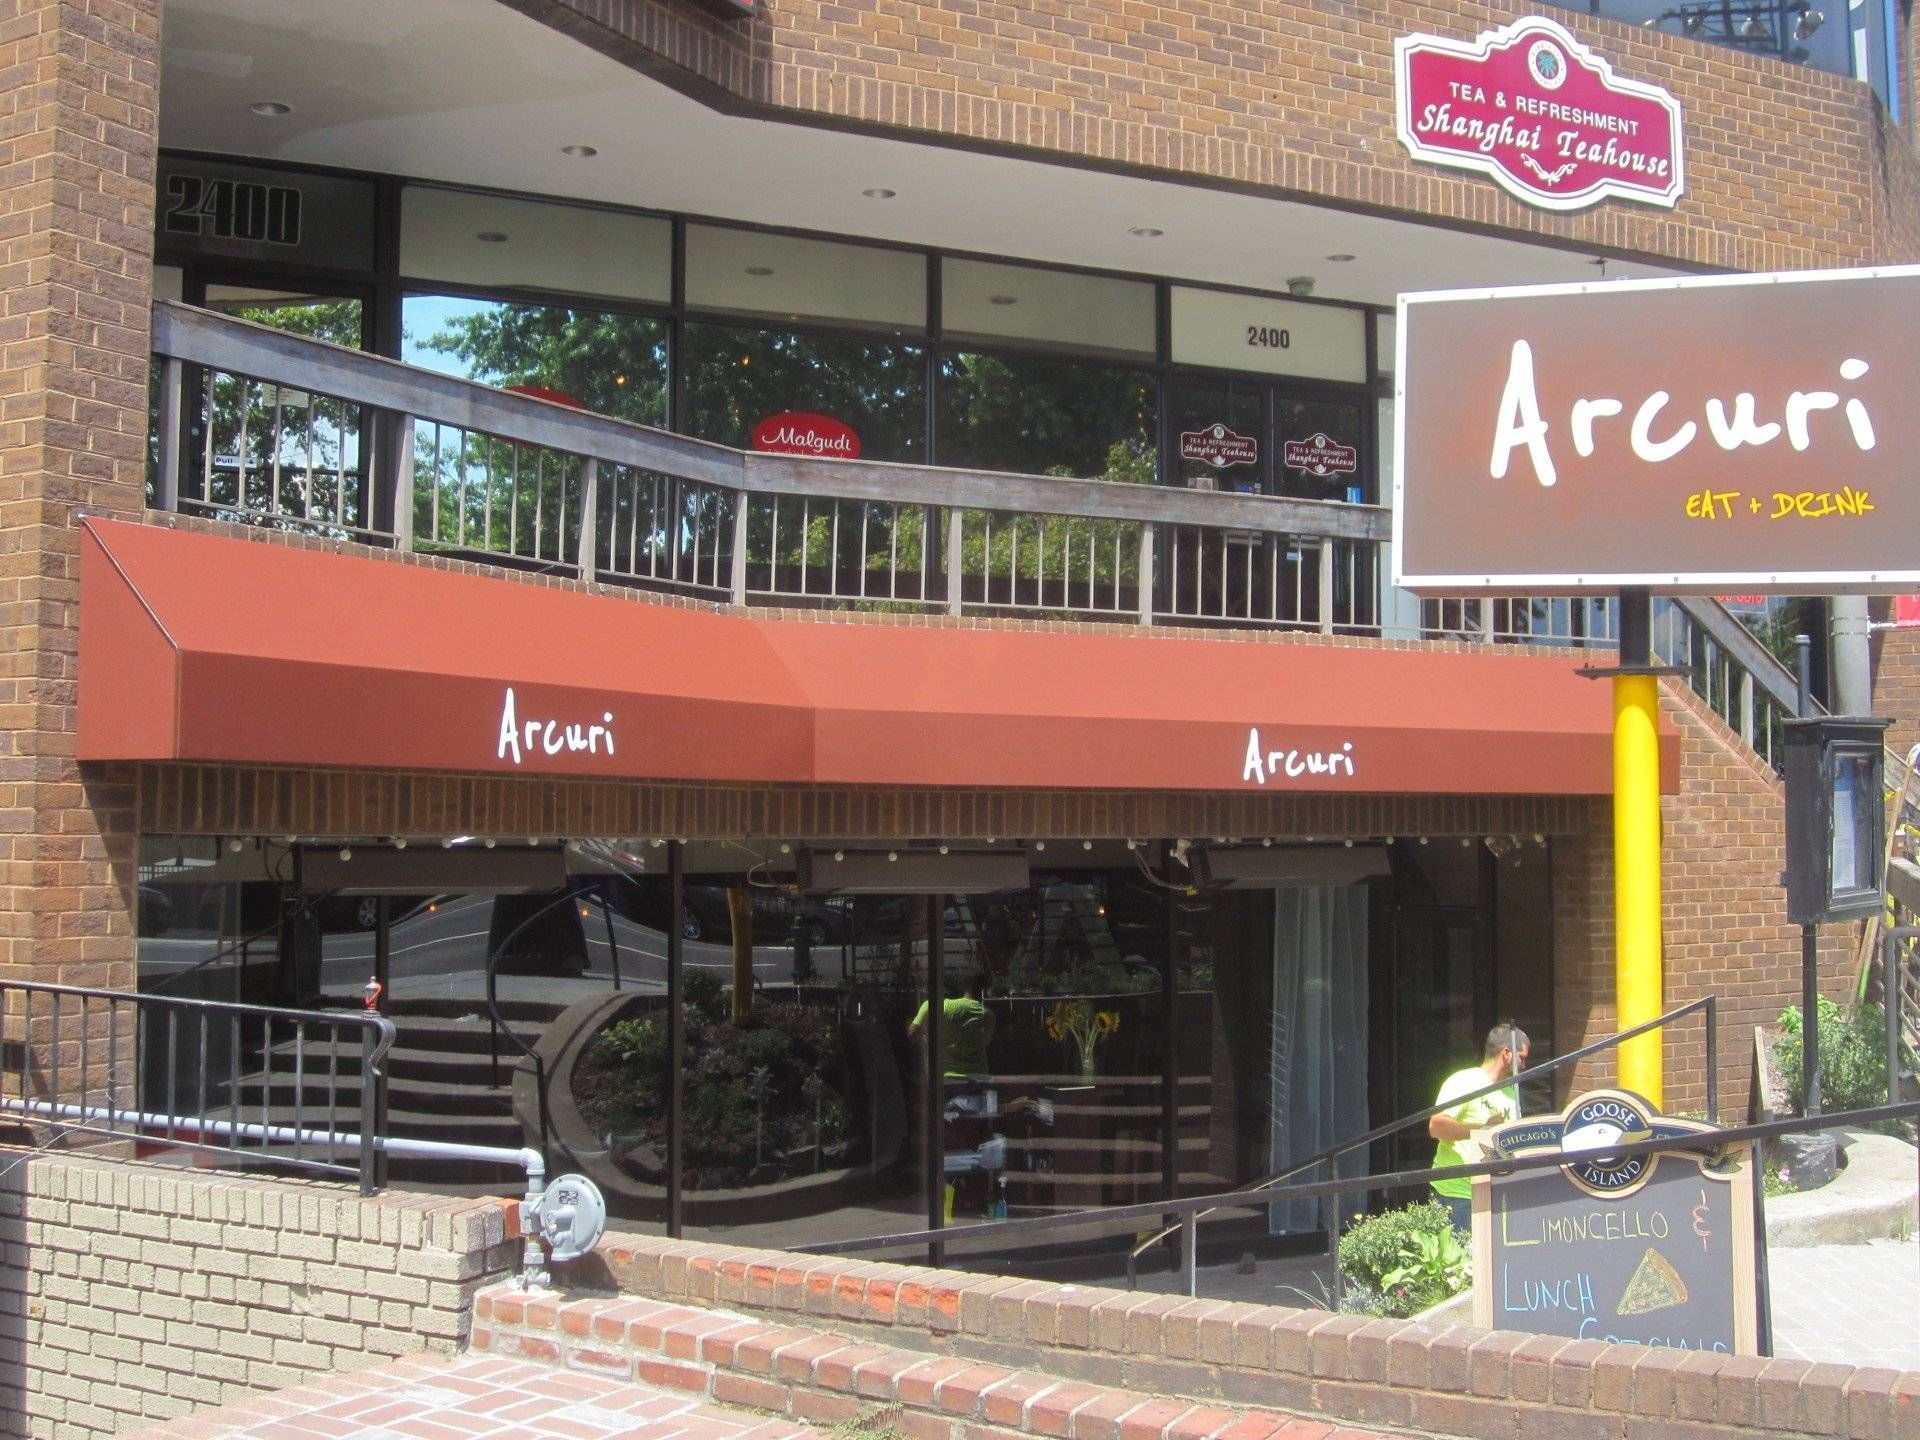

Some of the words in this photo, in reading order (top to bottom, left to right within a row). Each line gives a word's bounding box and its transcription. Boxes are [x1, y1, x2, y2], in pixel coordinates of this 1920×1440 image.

[1450, 81, 1486, 103] TEA
[1496, 92, 1507, 109] &
[1517, 95, 1639, 135] REFRESHMENT
[1418, 103, 1542, 152] Shanghai
[1557, 131, 1669, 178] Teahouse
[165, 174, 303, 246] 2400
[1248, 326, 1290, 349] 2400
[1489, 339, 1876, 487] Arcuri
[761, 427, 852, 453] Malgudi
[1184, 443, 1218, 458] Shanghai
[1221, 447, 1255, 458] Teahouse
[1190, 437, 1201, 445] TEA
[1208, 439, 1248, 448] REFRESHMENT
[1288, 452, 1319, 466] Shanghai
[1322, 457, 1354, 467] Teahouse
[1686, 489, 1740, 519] EAT
[1749, 497, 1762, 513] +
[1771, 486, 1875, 519] DRINK
[498, 687, 614, 764] Arcuri
[1243, 727, 1354, 785] Arcuri
[1581, 1103, 1636, 1126] GOOSE
[1499, 1129, 1557, 1149] CHICAGO'S
[1583, 1160, 1642, 1186] ISLAND
[1502, 1193, 1669, 1247] LIMONCELLO
[1504, 1261, 1596, 1313] LUNCH
